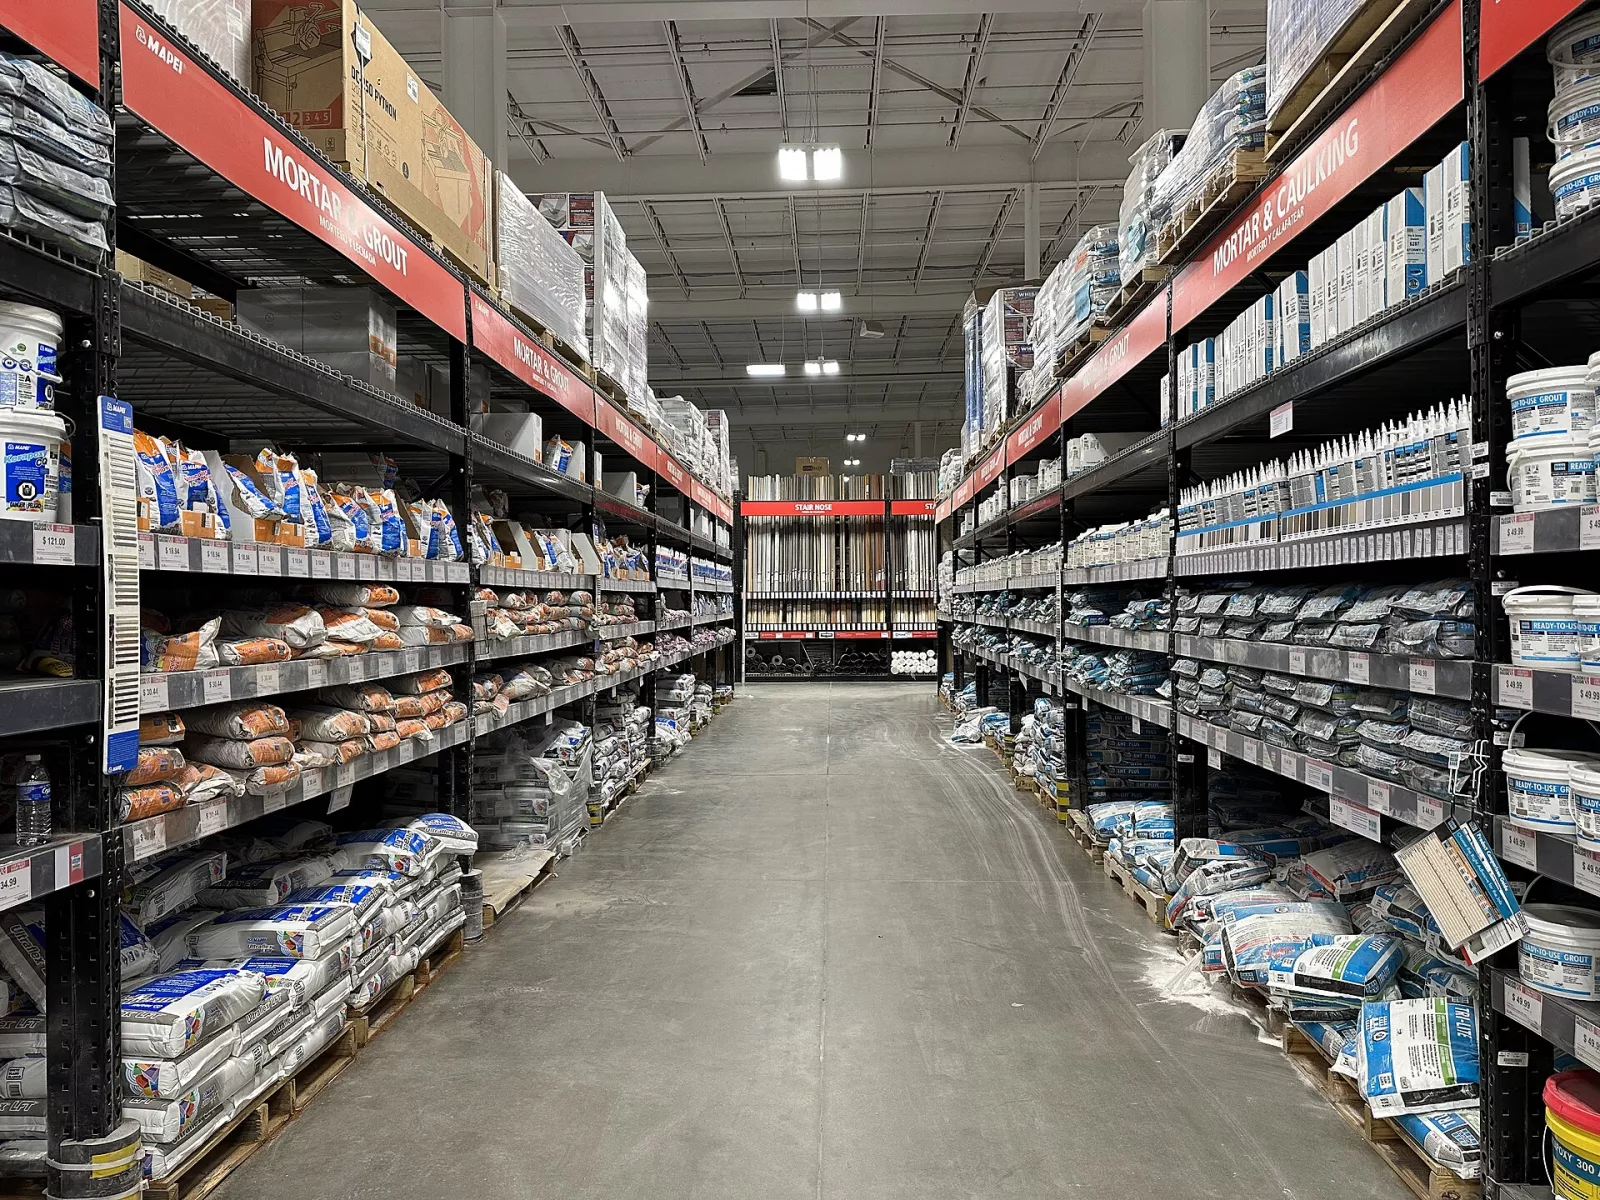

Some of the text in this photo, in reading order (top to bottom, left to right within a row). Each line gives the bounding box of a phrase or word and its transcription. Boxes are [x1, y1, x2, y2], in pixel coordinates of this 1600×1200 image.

[147, 34, 184, 75] MAPEI
[374, 89, 397, 121] PYTHON
[292, 112, 299, 124] 2
[304, 112, 310, 122] 3
[313, 112, 319, 121] 4
[323, 112, 329, 121] 5
[1212, 118, 1359, 277] MORTAR & CAULKING
[263, 136, 342, 223] MORTAR
[362, 222, 408, 277] GROUT
[319, 215, 348, 244] MORTERO
[353, 238, 377, 267] LECHADA
[1246, 241, 1268, 263] MORTERO
[1272, 207, 1305, 240] CALAFATEAR
[1110, 332, 1130, 366] GROUT
[513, 335, 542, 375] MORTAR
[544, 359, 550, 380] &
[550, 365, 569, 392] GROUT
[1539, 393, 1563, 404] GROUT
[4, 449, 48, 465] Kerapoxy
[35, 457, 48, 467] CQ
[795, 503, 833, 511] STAIR NOSE
[48, 537, 66, 546] 121.00
[1510, 681, 1523, 689] 49.99
[1585, 690, 1600, 700] 49.99
[1515, 779, 1557, 793] READY-TO-USE
[0, 877, 17, 890] 34.99
[10, 923, 46, 966] Ultraflex
[1522, 942, 1589, 964] READY-TO-USE GROUT
[1516, 995, 1531, 1010] 49.99
[247, 1000, 271, 1025] Ultraflex
[15, 1018, 44, 1029] LFT
[1454, 1007, 1473, 1039] TRI-LITE
[9, 1100, 39, 1112] LFT
[1434, 1112, 1456, 1129] TRI
[1576, 1158, 1595, 1174] 300
